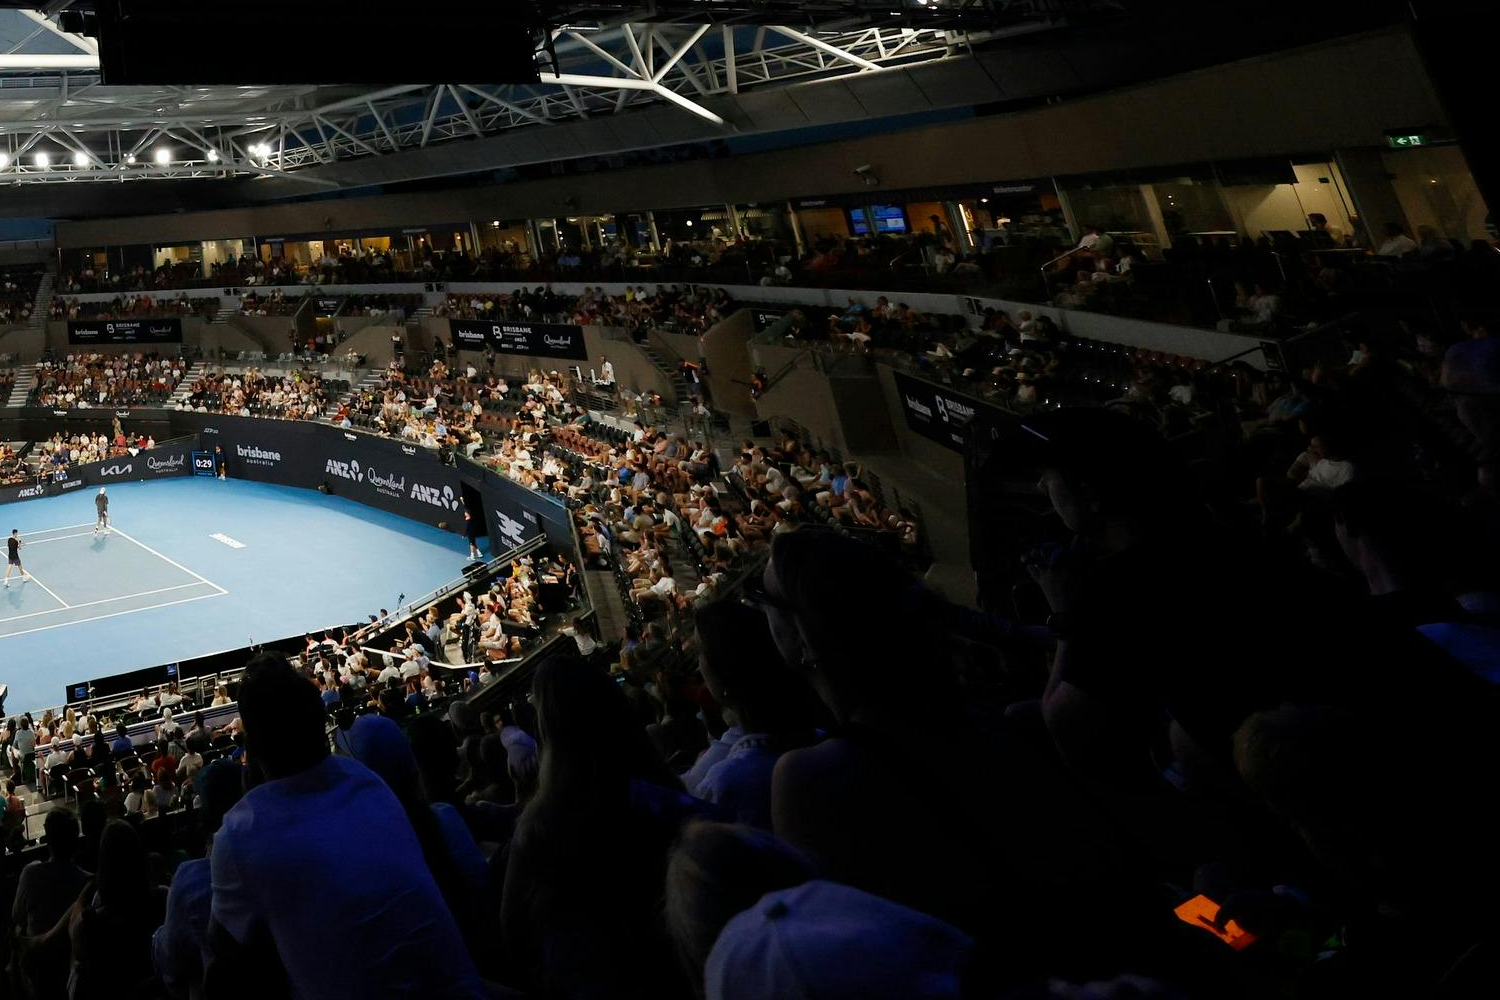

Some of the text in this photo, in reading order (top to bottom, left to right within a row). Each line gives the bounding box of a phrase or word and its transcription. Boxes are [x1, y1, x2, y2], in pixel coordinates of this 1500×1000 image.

[237, 444, 281, 461] brisbane
[146, 453, 185, 470] Queensland
[196, 459, 212, 468] 0:29
[325, 459, 350, 480] ANZ
[368, 467, 406, 493] Queensland
[18, 489, 35, 499] ANZ
[411, 482, 442, 506] ANZ
